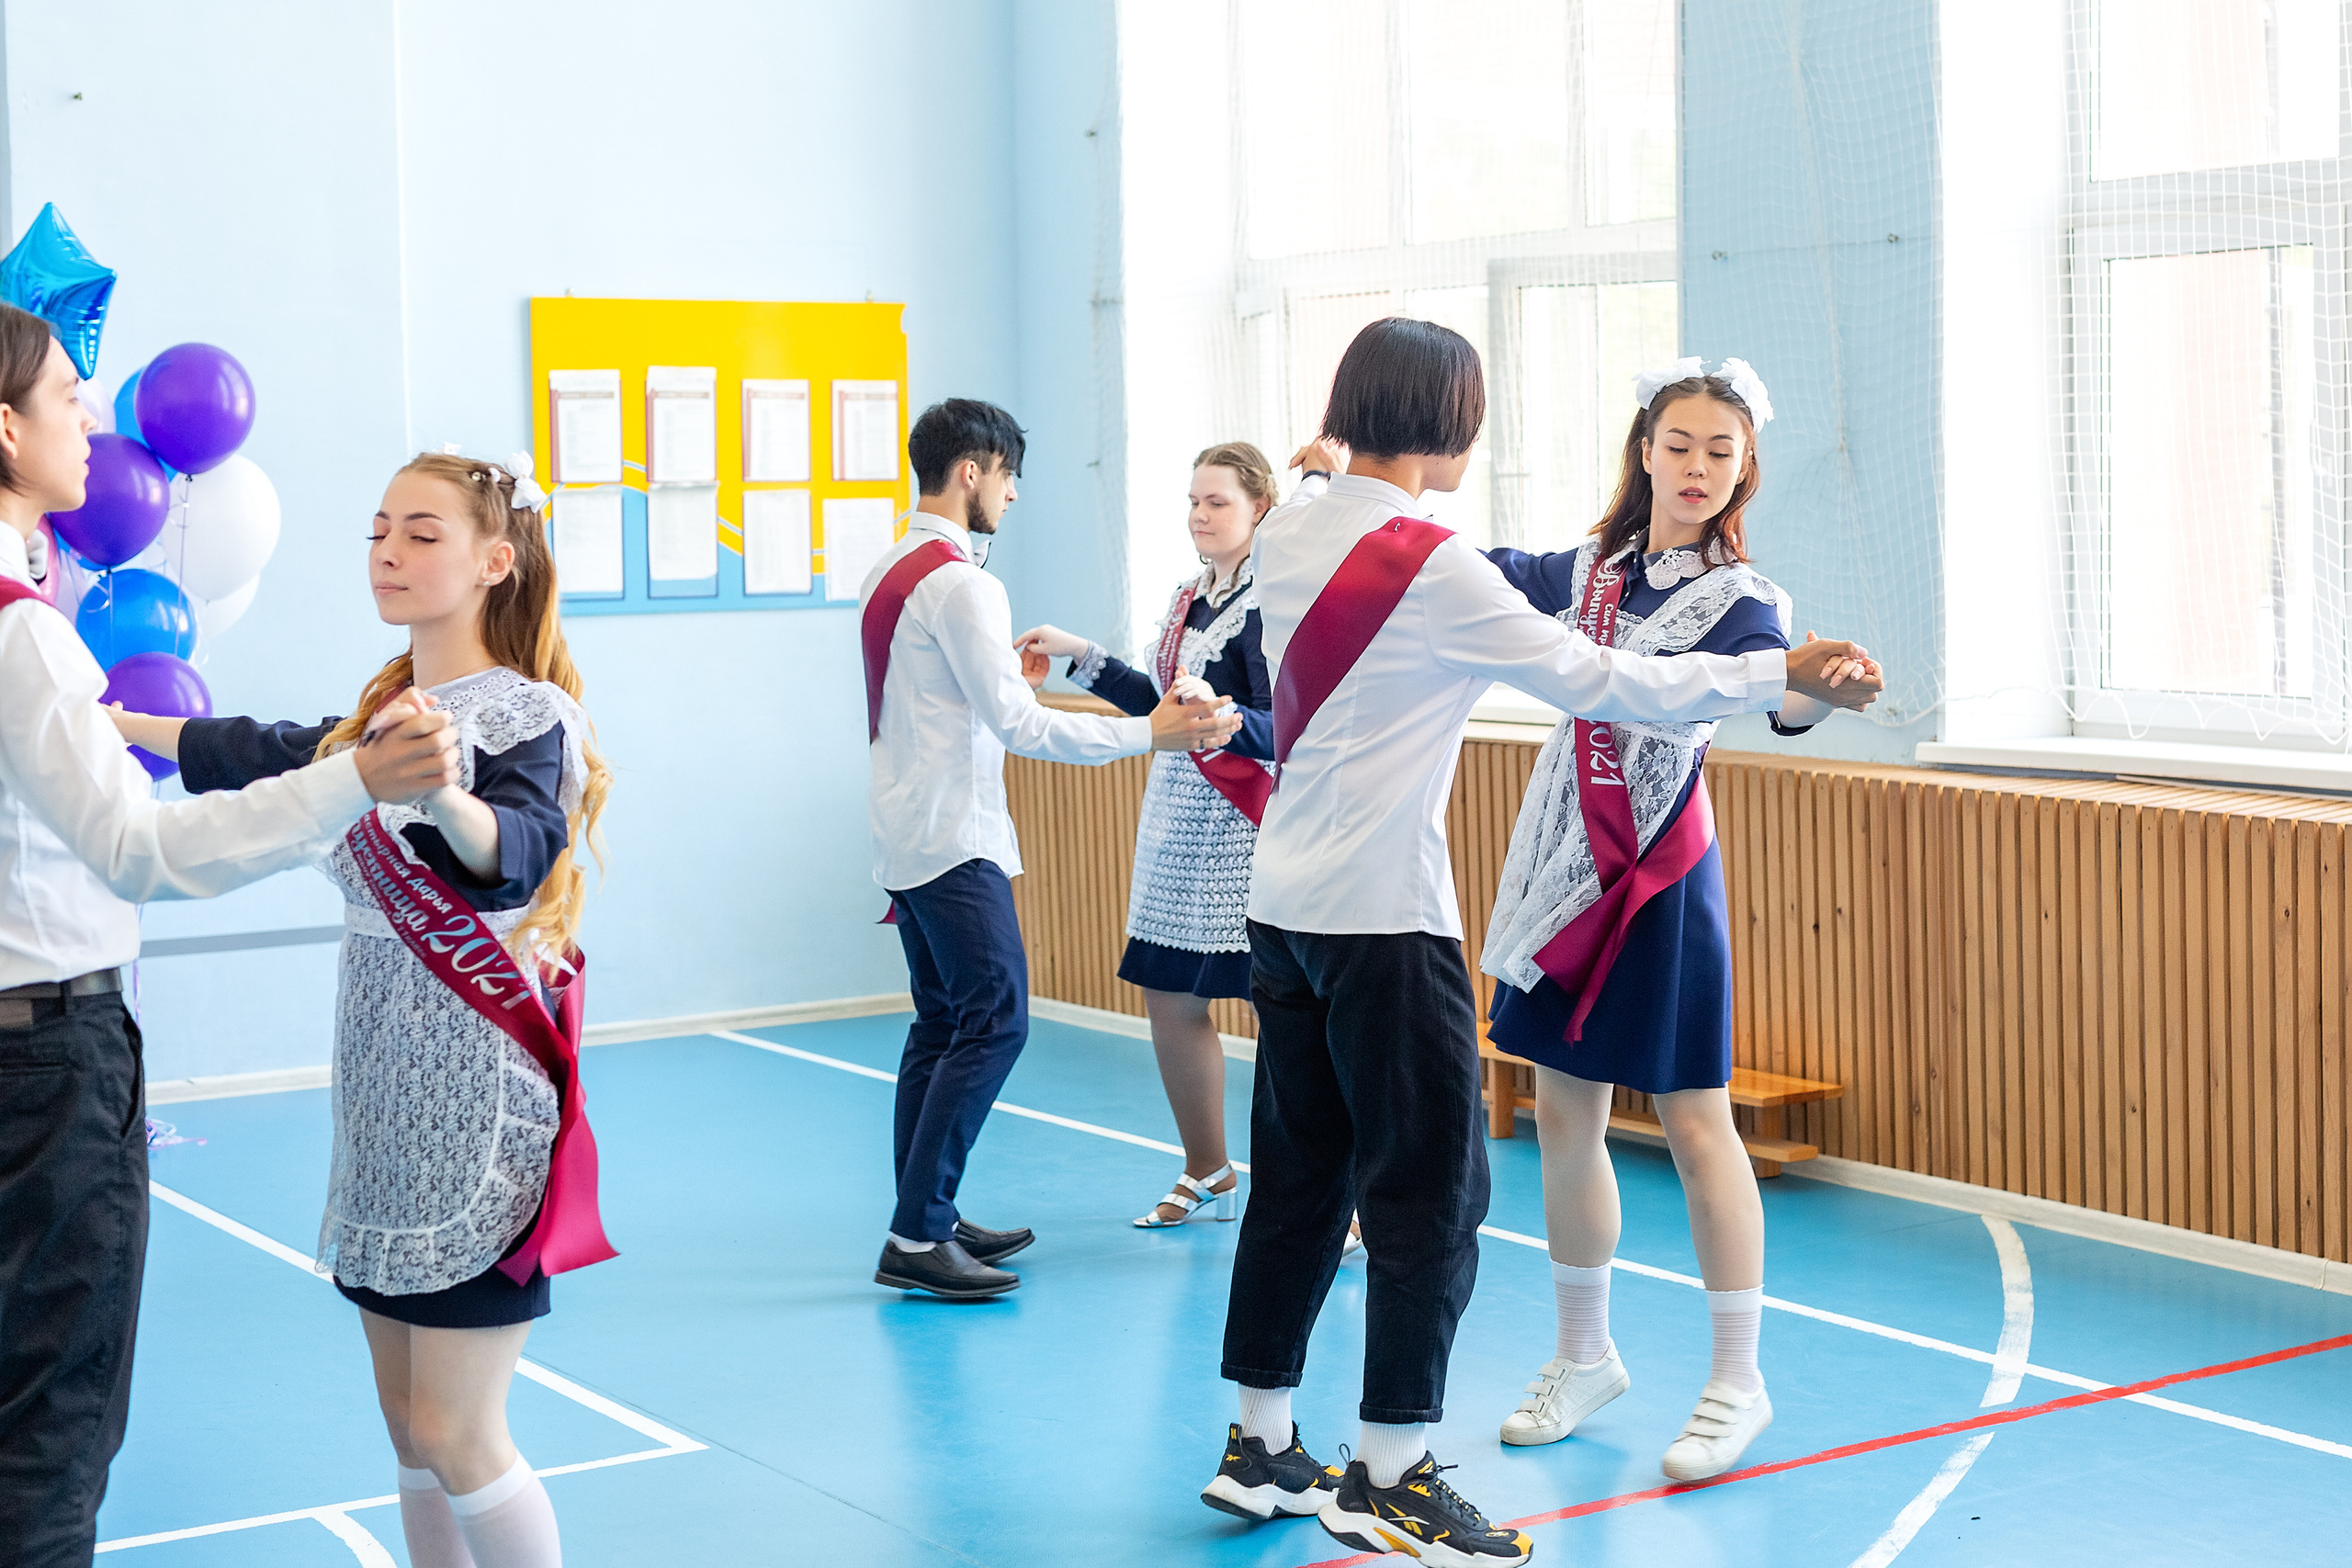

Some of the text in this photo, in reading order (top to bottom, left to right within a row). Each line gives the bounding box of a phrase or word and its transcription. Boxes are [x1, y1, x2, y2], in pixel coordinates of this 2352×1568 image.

[1602, 603, 1614, 626] Сим
[1589, 720, 1624, 786] 021
[406, 877, 453, 913] Дарья
[421, 915, 531, 1010] 2021
